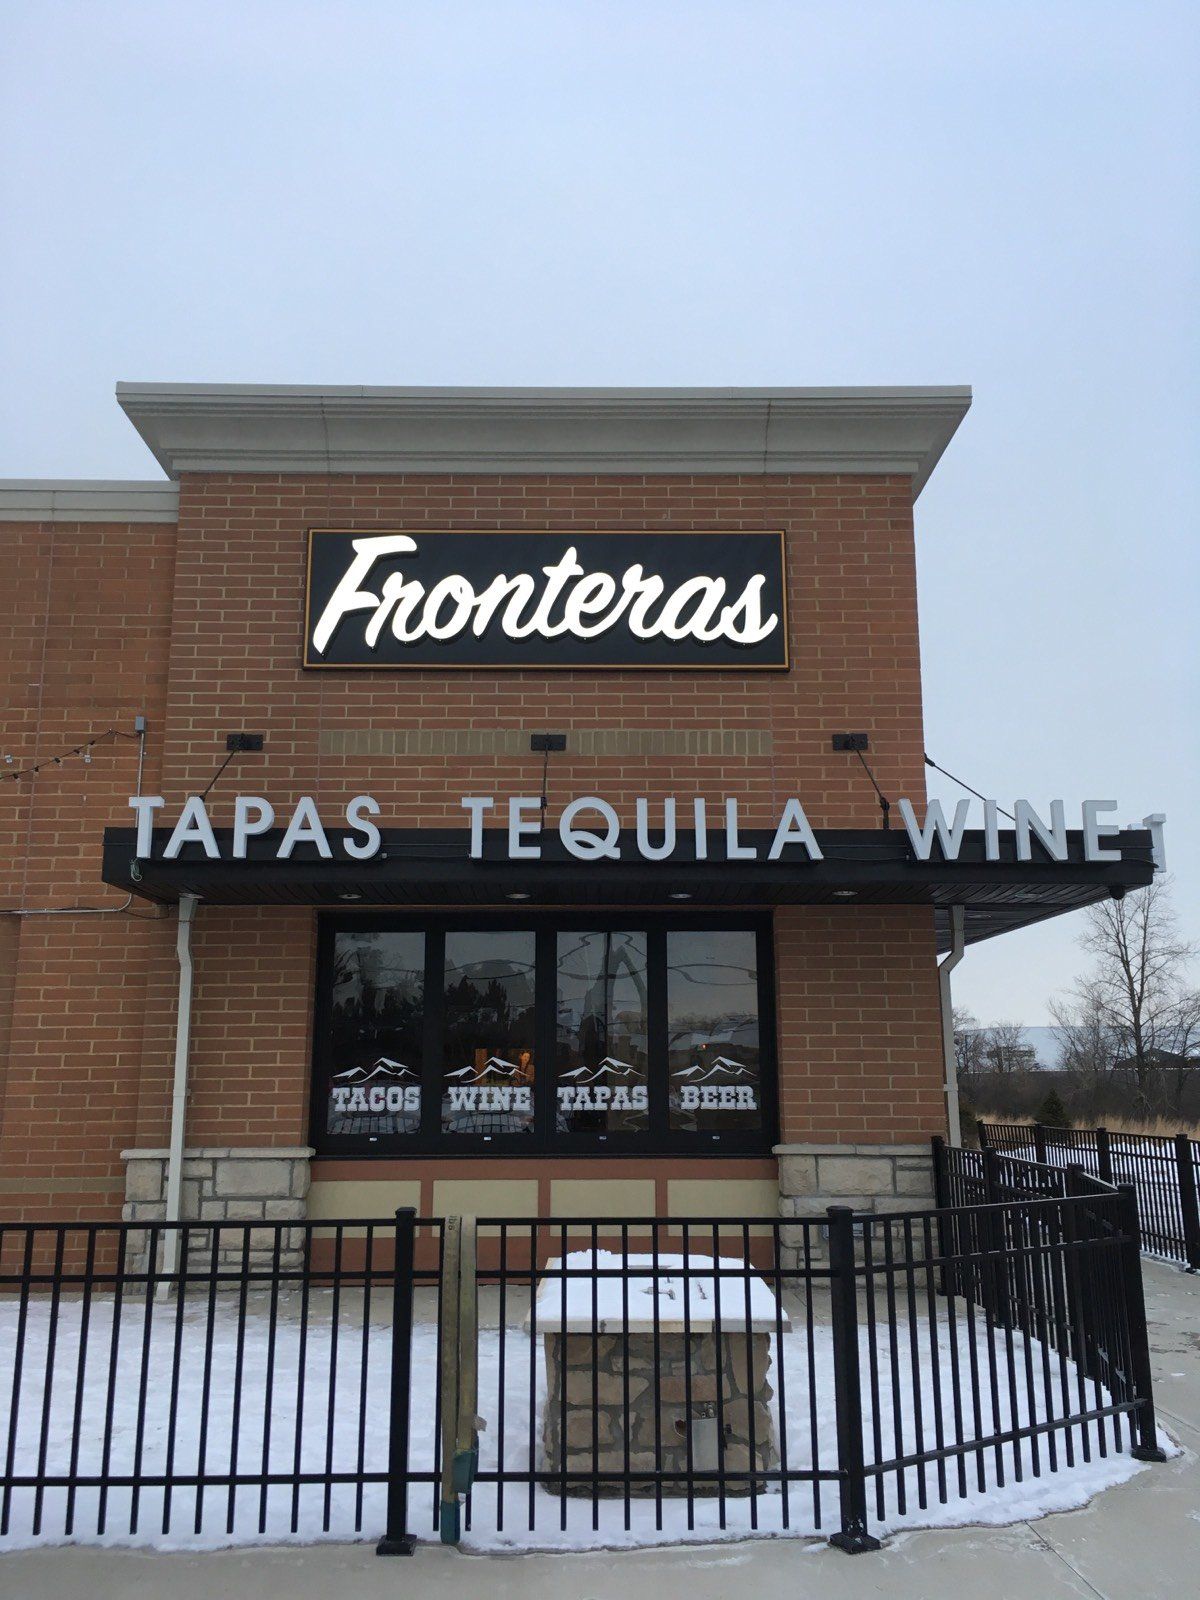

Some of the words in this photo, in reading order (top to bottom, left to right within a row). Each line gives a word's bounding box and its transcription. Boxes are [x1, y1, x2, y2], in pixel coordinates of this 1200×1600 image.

[312, 535, 778, 654] Fronteras
[128, 795, 382, 860] TAPAS
[461, 796, 824, 861] TEQUILA
[897, 798, 1121, 861] WINE
[332, 1086, 421, 1112] TACOS
[448, 1086, 531, 1111] WINE
[556, 1086, 648, 1111] TAPAS
[680, 1086, 758, 1110] BEER
